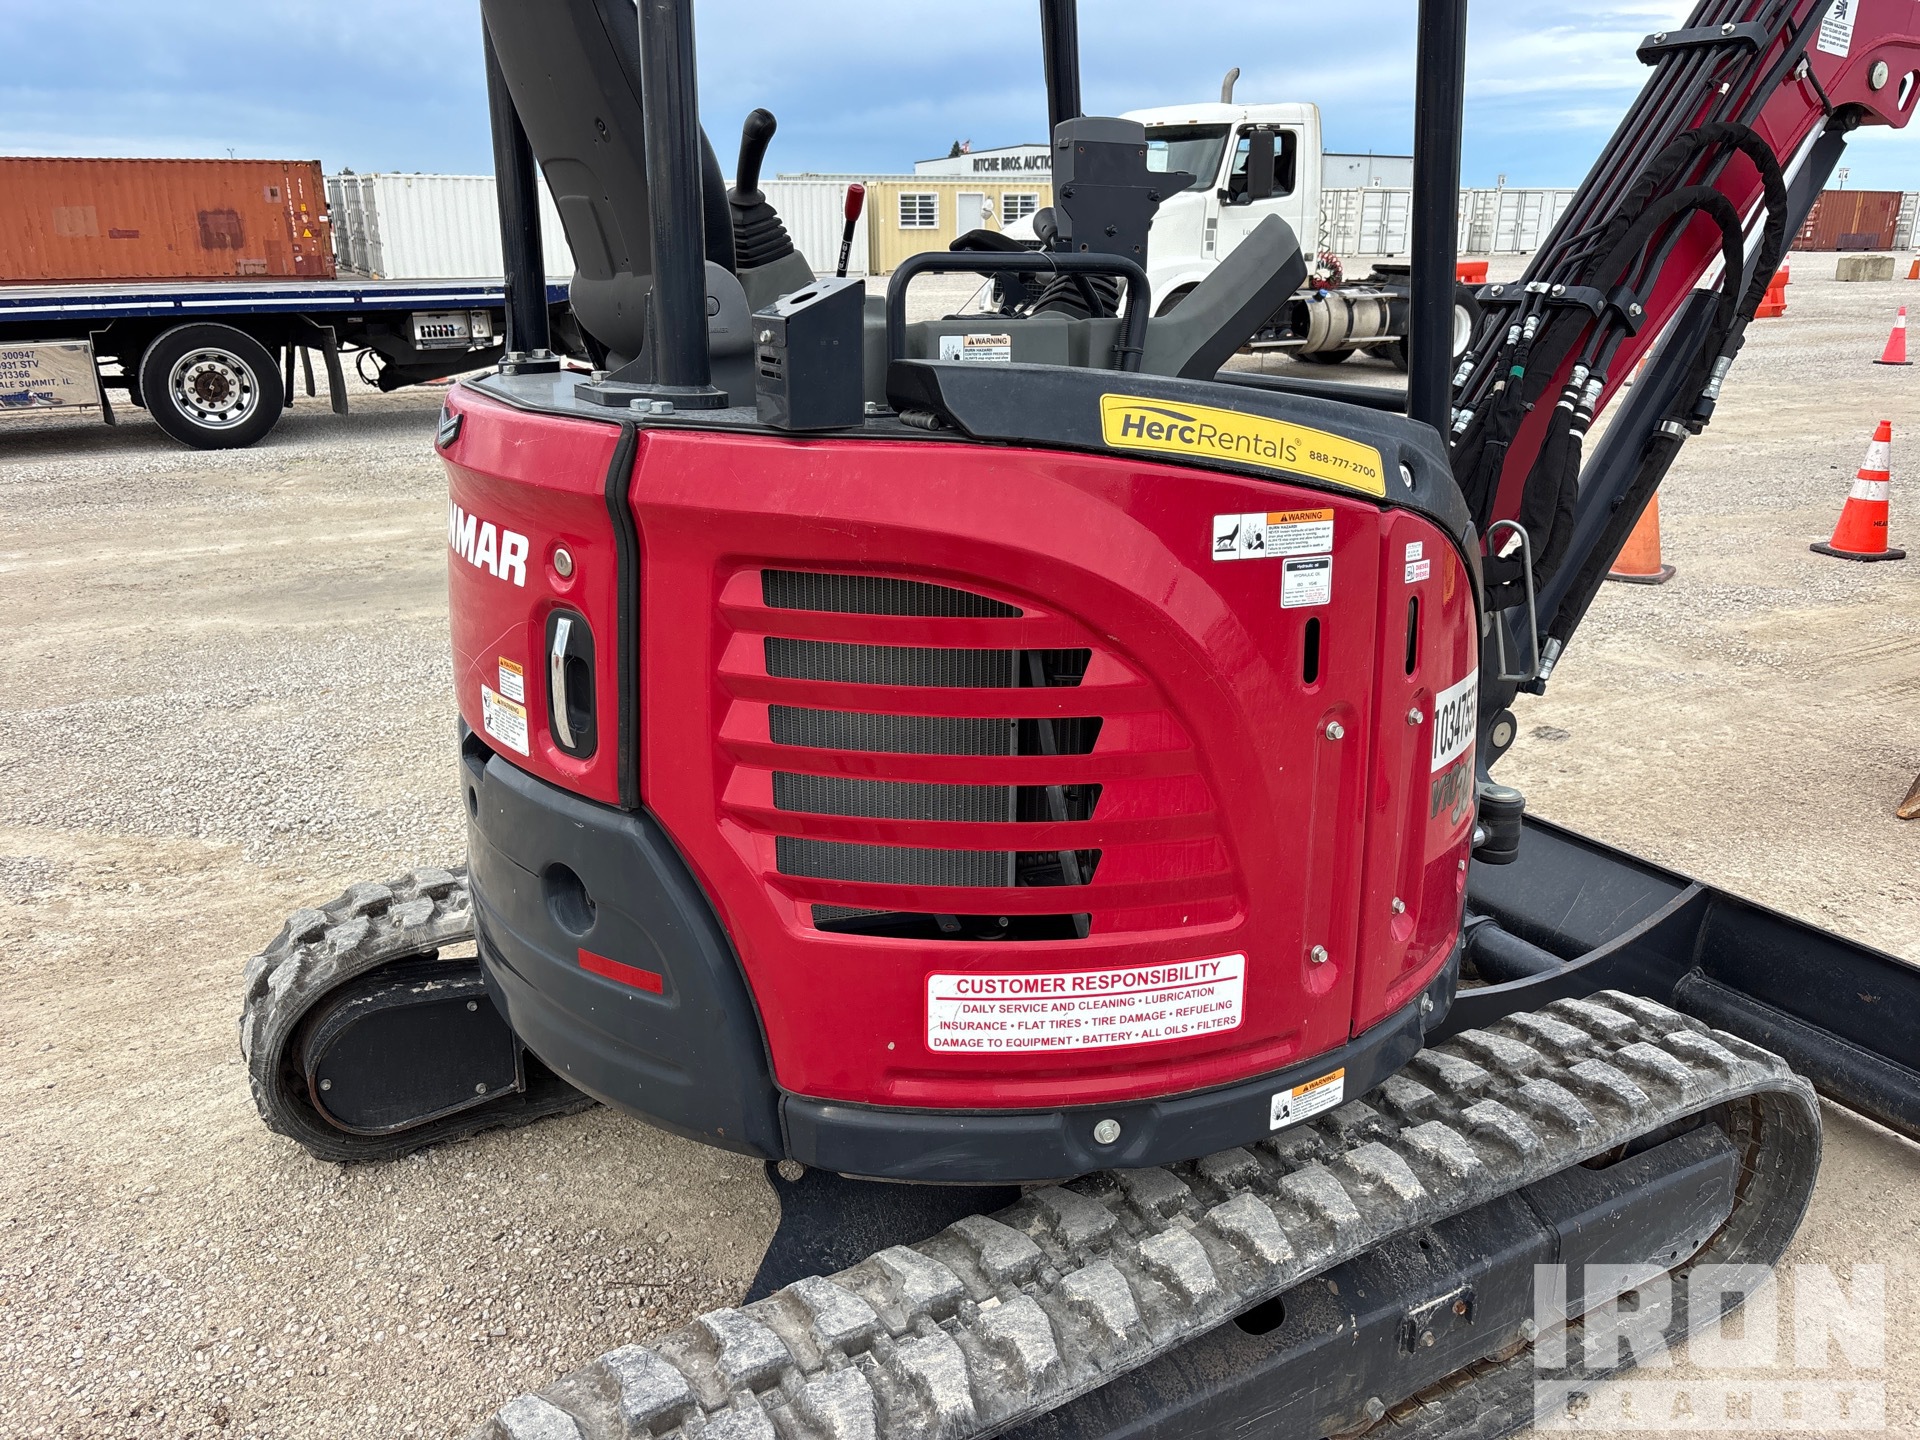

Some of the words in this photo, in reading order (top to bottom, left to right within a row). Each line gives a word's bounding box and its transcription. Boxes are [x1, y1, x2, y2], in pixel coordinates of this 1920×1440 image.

[974, 158, 999, 172] RITCHIE
[1001, 156, 1022, 170] BROS.
[2, 351, 34, 360] 300947
[20, 360, 38, 368] STV
[1310, 450, 1376, 478] 888-777-2700
[1288, 512, 1322, 520] WARNING
[957, 978, 1065, 994] CUSTOMER
[1072, 962, 1220, 991] RESPONSIBILITY
[962, 1004, 996, 1013] DAILY
[998, 1004, 1048, 1013] SERVICE
[1051, 1002, 1075, 1011] AND
[1078, 997, 1135, 1010] CLEANING
[1146, 987, 1214, 1004] LUBRICATION
[940, 1021, 1007, 1030] INSURANCE
[1018, 1021, 1046, 1030] FLAT
[1049, 1019, 1081, 1028] TIRES
[1092, 1016, 1116, 1026] TIRE
[1120, 1010, 1166, 1024] DAMAGE
[1176, 1000, 1232, 1017] REFUELING
[934, 1038, 983, 1047] DAMAGE
[987, 1038, 1002, 1047] TO
[1006, 1036, 1072, 1047] EQUIPMENT
[1082, 1031, 1132, 1044] BATTERY
[1142, 1029, 1162, 1038] ALL
[1164, 1024, 1188, 1035] OILS
[1198, 1016, 1236, 1030] FILTERS
[1310, 1074, 1336, 1088] WARNING
